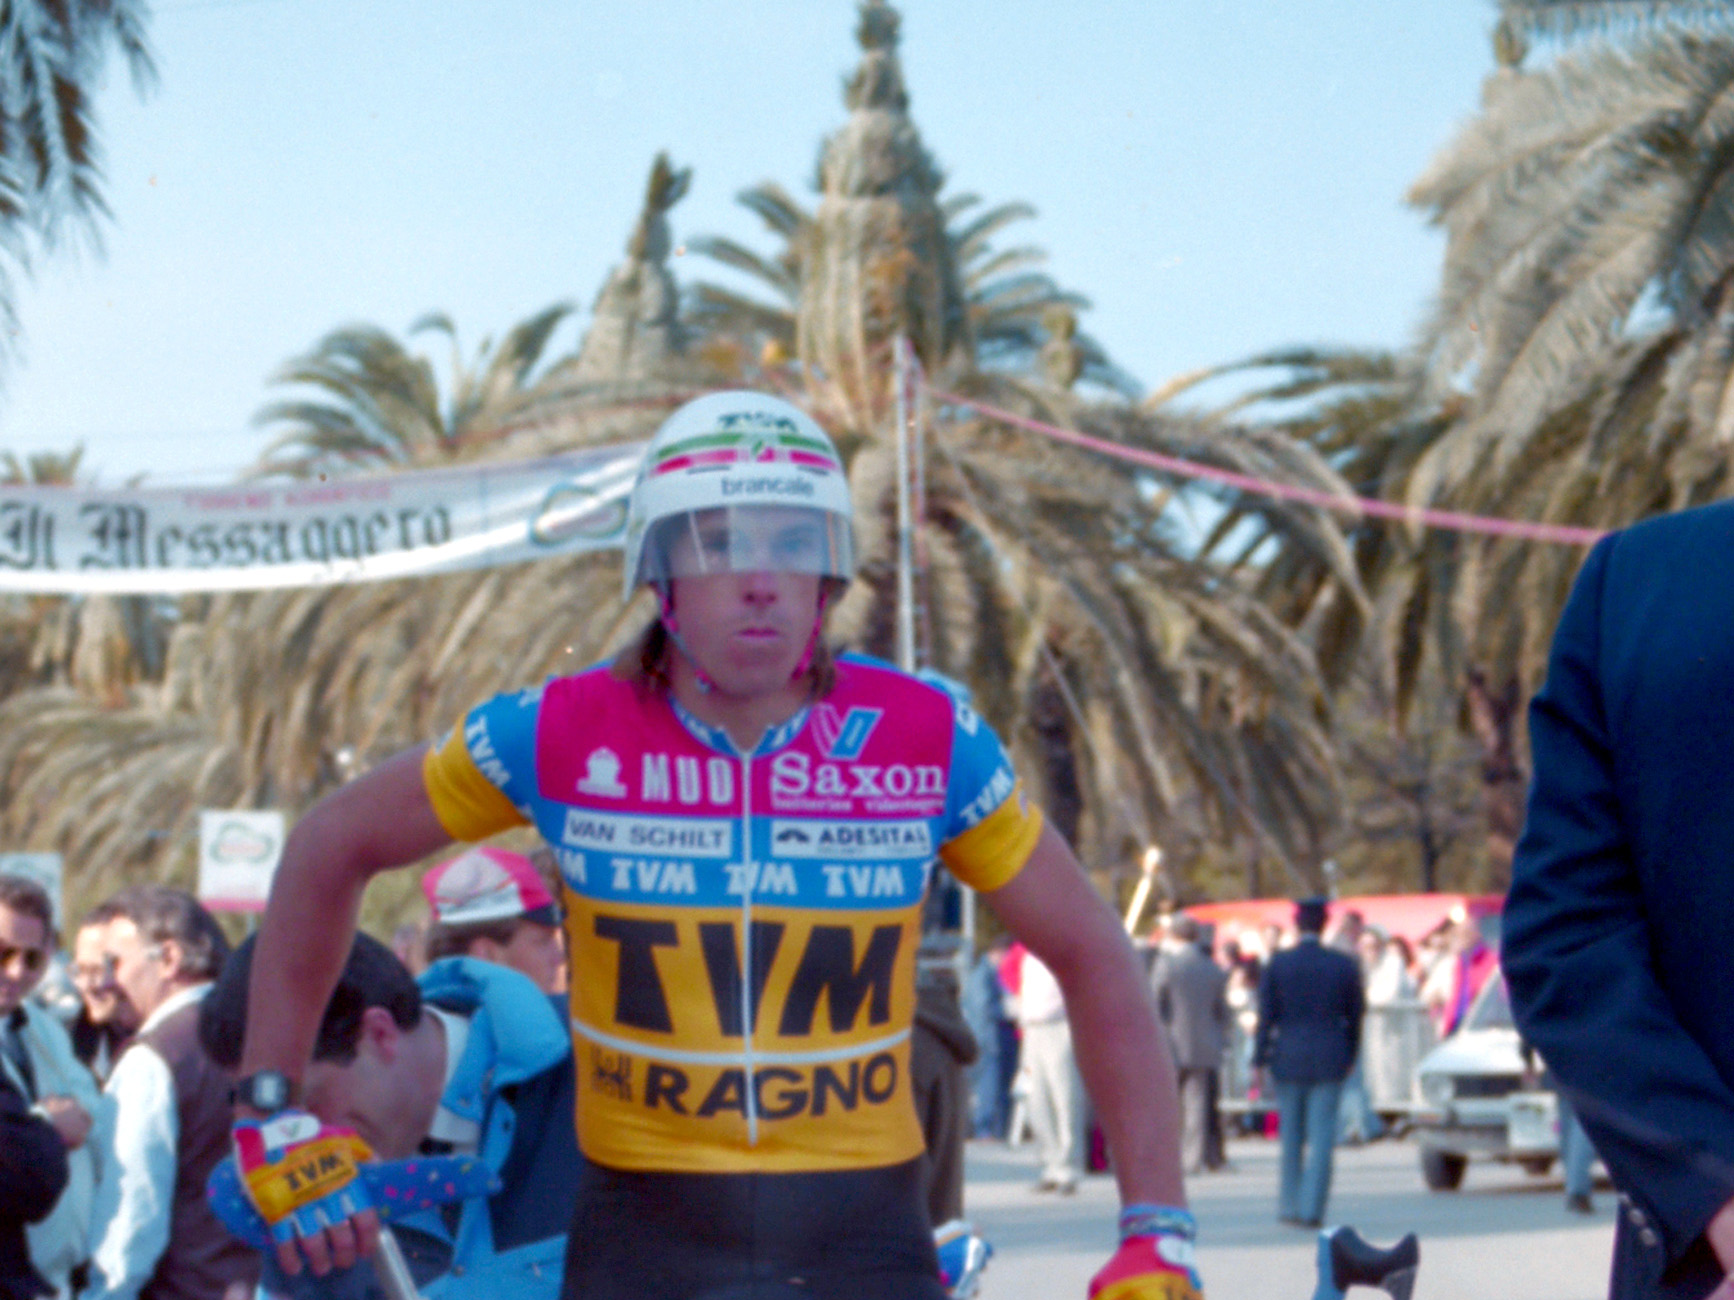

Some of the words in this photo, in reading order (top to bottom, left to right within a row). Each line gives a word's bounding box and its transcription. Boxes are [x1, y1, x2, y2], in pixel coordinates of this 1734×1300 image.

[720, 476, 814, 498] brancale
[78, 502, 452, 574] Messaggero
[465, 714, 512, 787] TVM
[771, 750, 947, 797] Saxon
[569, 819, 615, 842] VAN
[629, 824, 725, 848] SCHILT
[611, 858, 697, 894] TVM
[724, 862, 798, 896] TVM
[822, 865, 905, 897] TVM
[593, 914, 904, 1037] TVM
[644, 1053, 898, 1121] RAGNO
